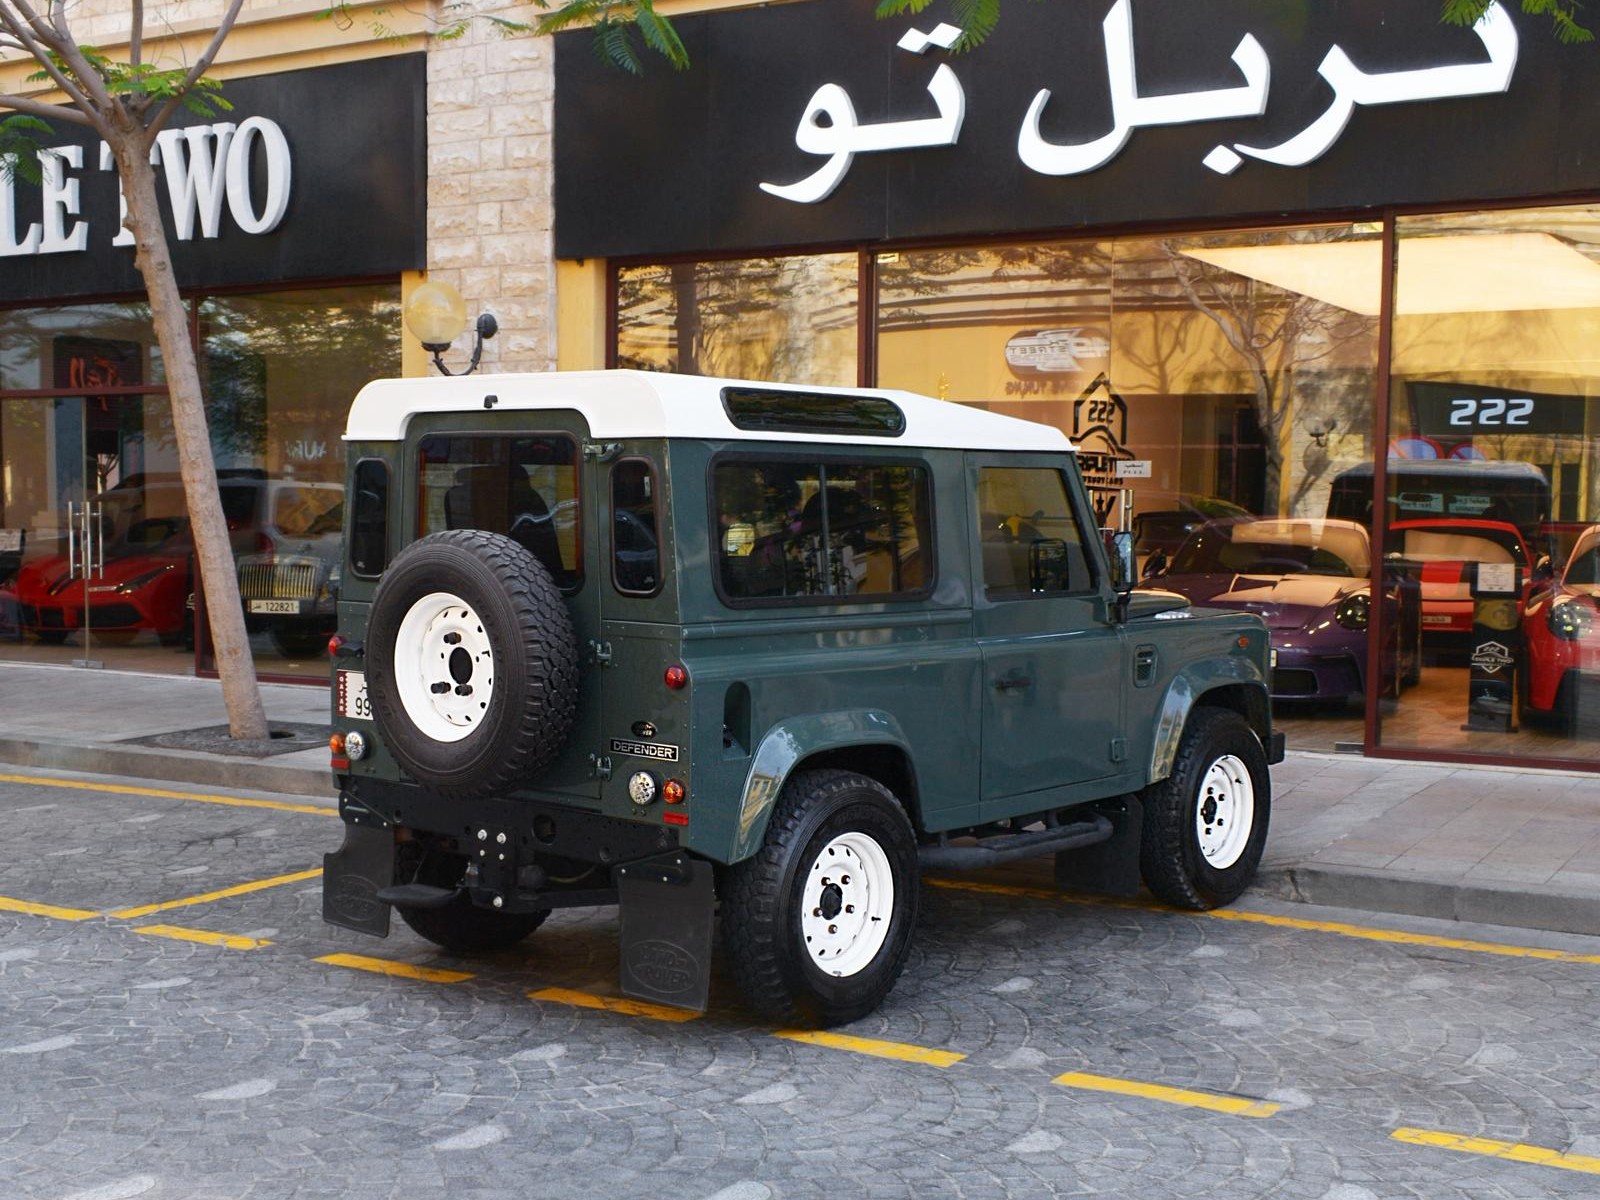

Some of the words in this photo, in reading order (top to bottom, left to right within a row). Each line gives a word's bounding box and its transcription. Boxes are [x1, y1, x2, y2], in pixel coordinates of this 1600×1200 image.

[759, 22, 965, 203] تو
[1088, 400, 1116, 424] 222
[1449, 399, 1534, 426] 222
[613, 740, 673, 759] DEFENDER
